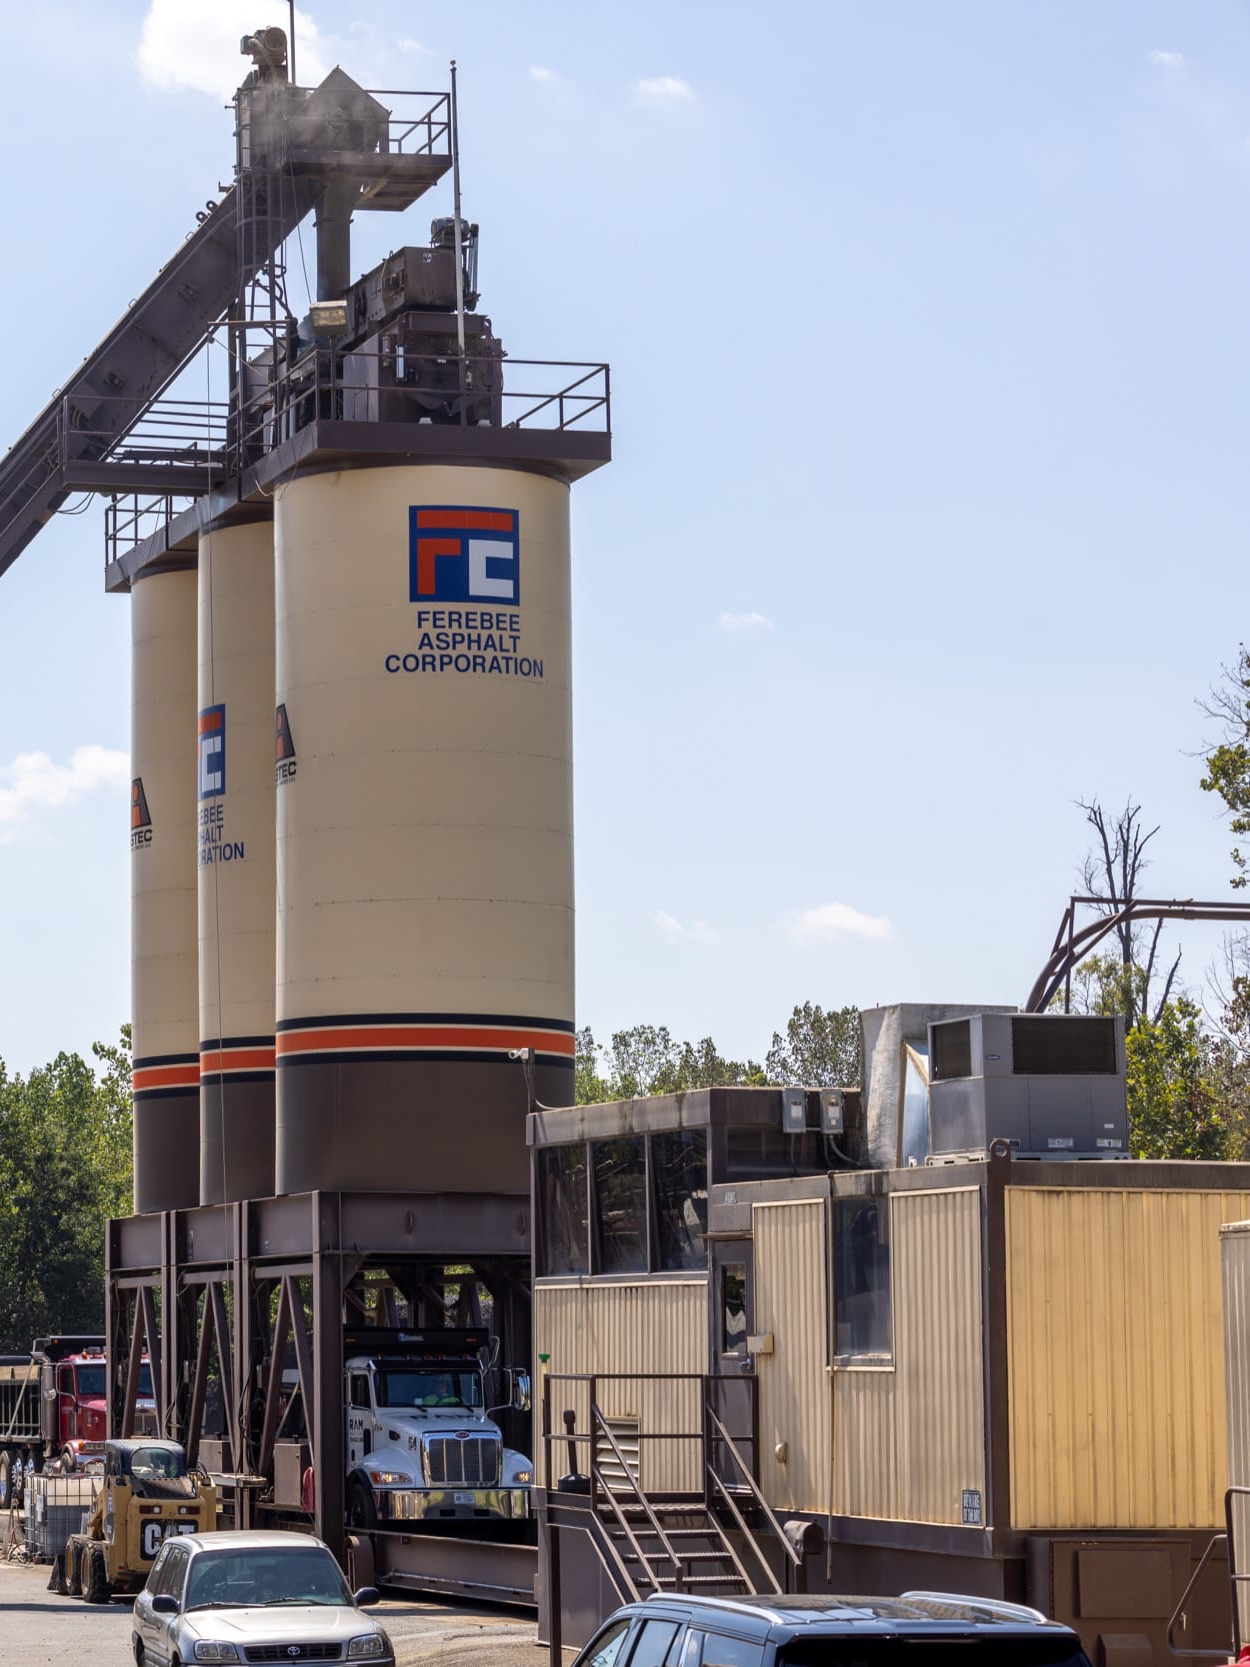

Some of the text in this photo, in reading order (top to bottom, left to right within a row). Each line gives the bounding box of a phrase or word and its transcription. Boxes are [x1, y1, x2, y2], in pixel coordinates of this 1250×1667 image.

[417, 610, 521, 632] FEREBEE
[418, 632, 521, 653] ASPHALT
[385, 653, 544, 678] CORPORATION
[199, 842, 245, 868] RATION
